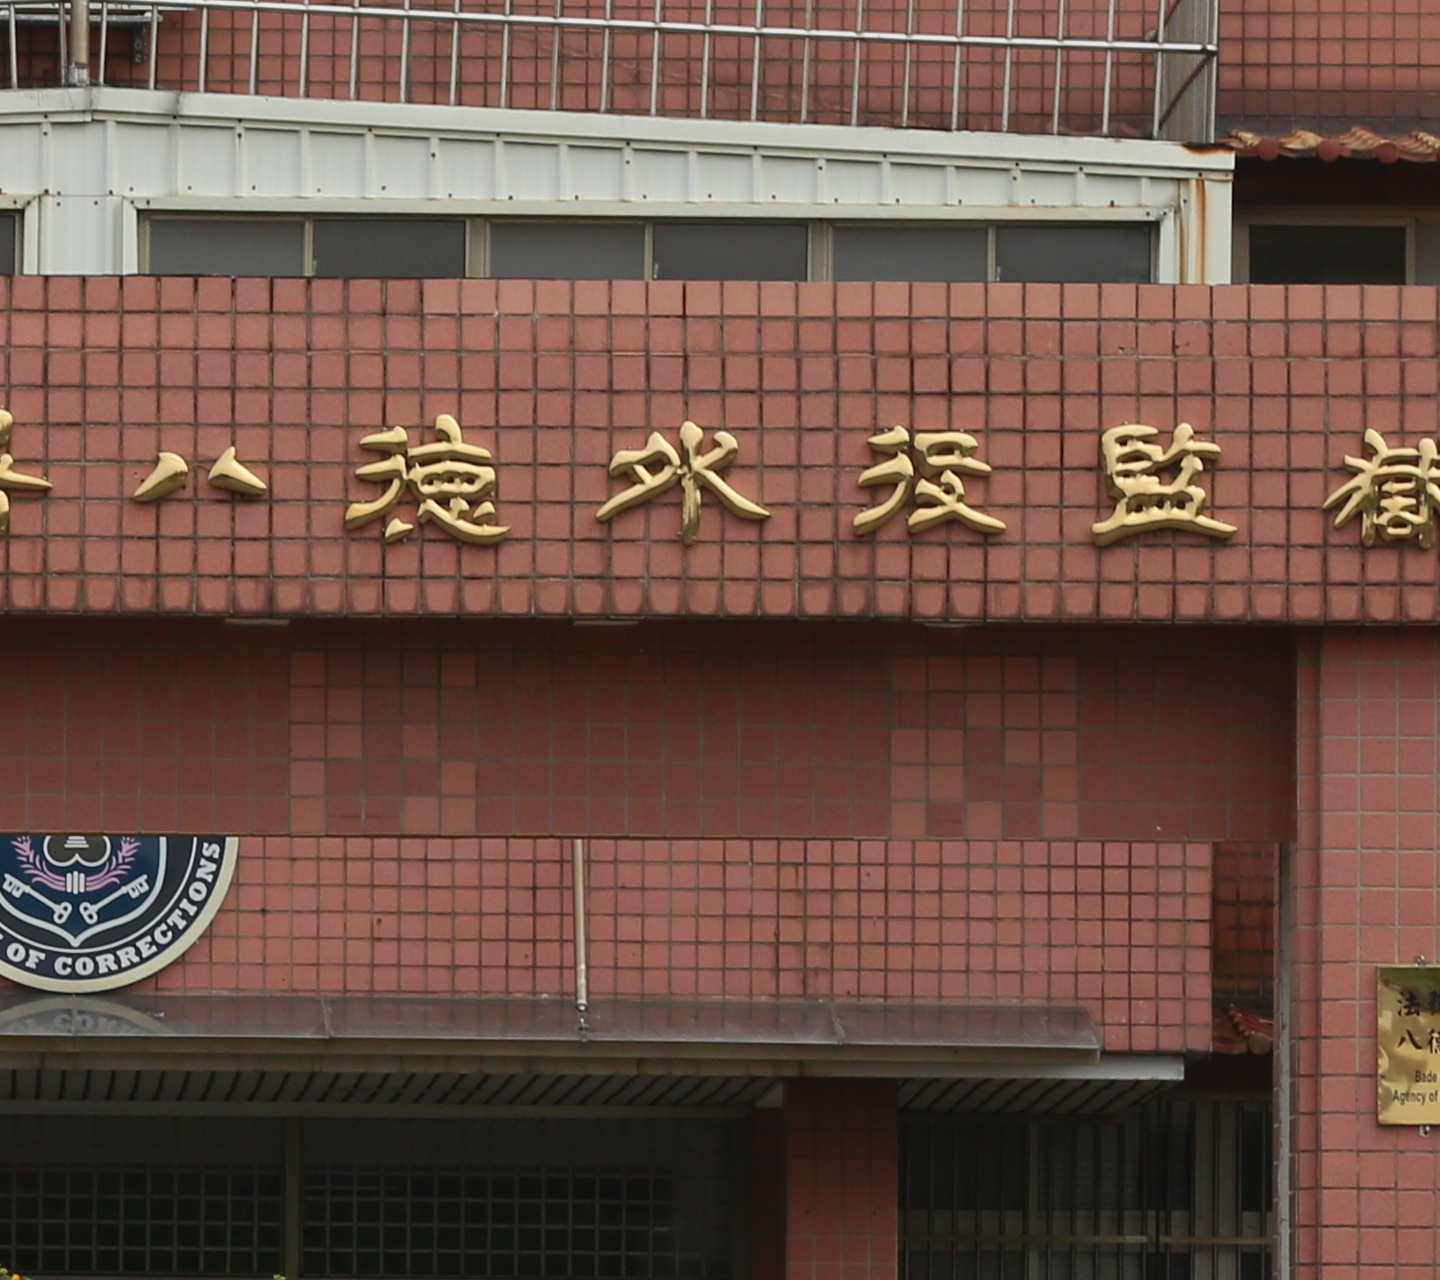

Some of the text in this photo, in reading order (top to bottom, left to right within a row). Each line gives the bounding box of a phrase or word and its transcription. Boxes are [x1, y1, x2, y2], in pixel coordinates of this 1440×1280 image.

[6, 941, 46, 969] OF
[54, 841, 221, 977] CORRECTIONS
[1414, 1070, 1438, 1083] Bade
[1392, 1090, 1427, 1106] Agency
[1429, 1091, 1439, 1103] of
